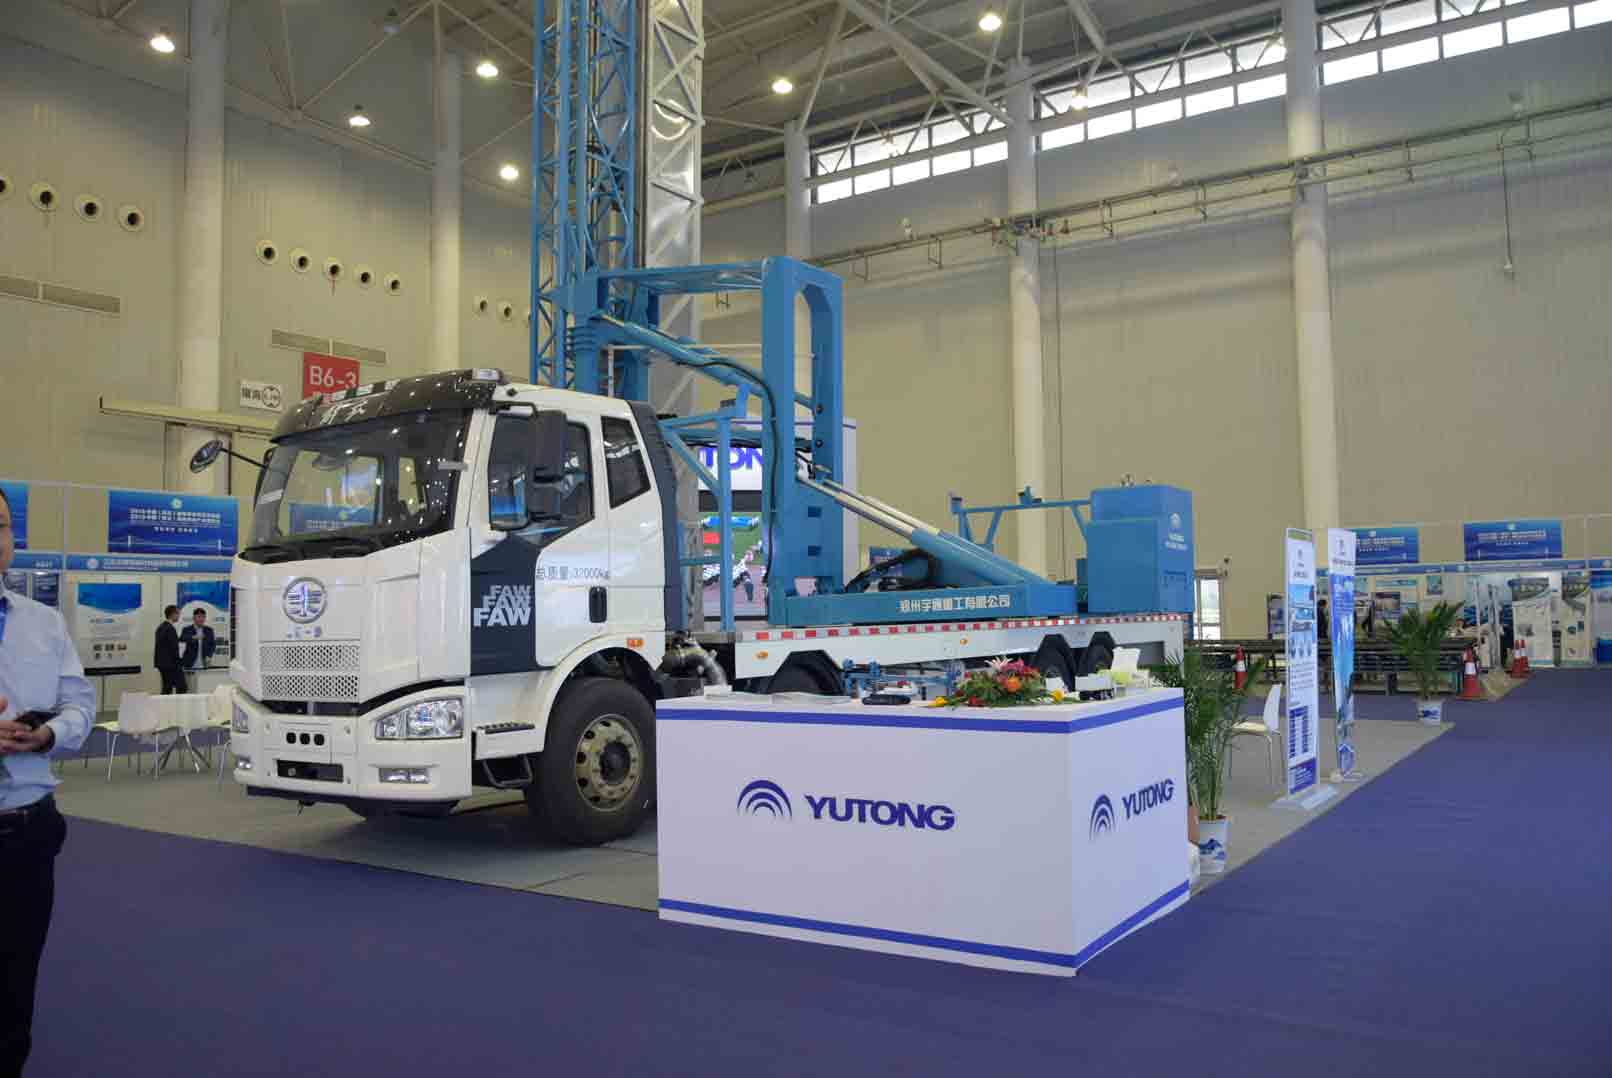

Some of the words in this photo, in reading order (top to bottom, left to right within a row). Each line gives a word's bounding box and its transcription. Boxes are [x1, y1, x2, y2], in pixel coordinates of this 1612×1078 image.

[309, 365, 356, 390] B6-3
[483, 595, 531, 608] FAW
[490, 585, 531, 596] FAW
[473, 607, 531, 627] FAW
[1121, 778, 1175, 820] YUTONG
[804, 795, 955, 831] YUTONG
